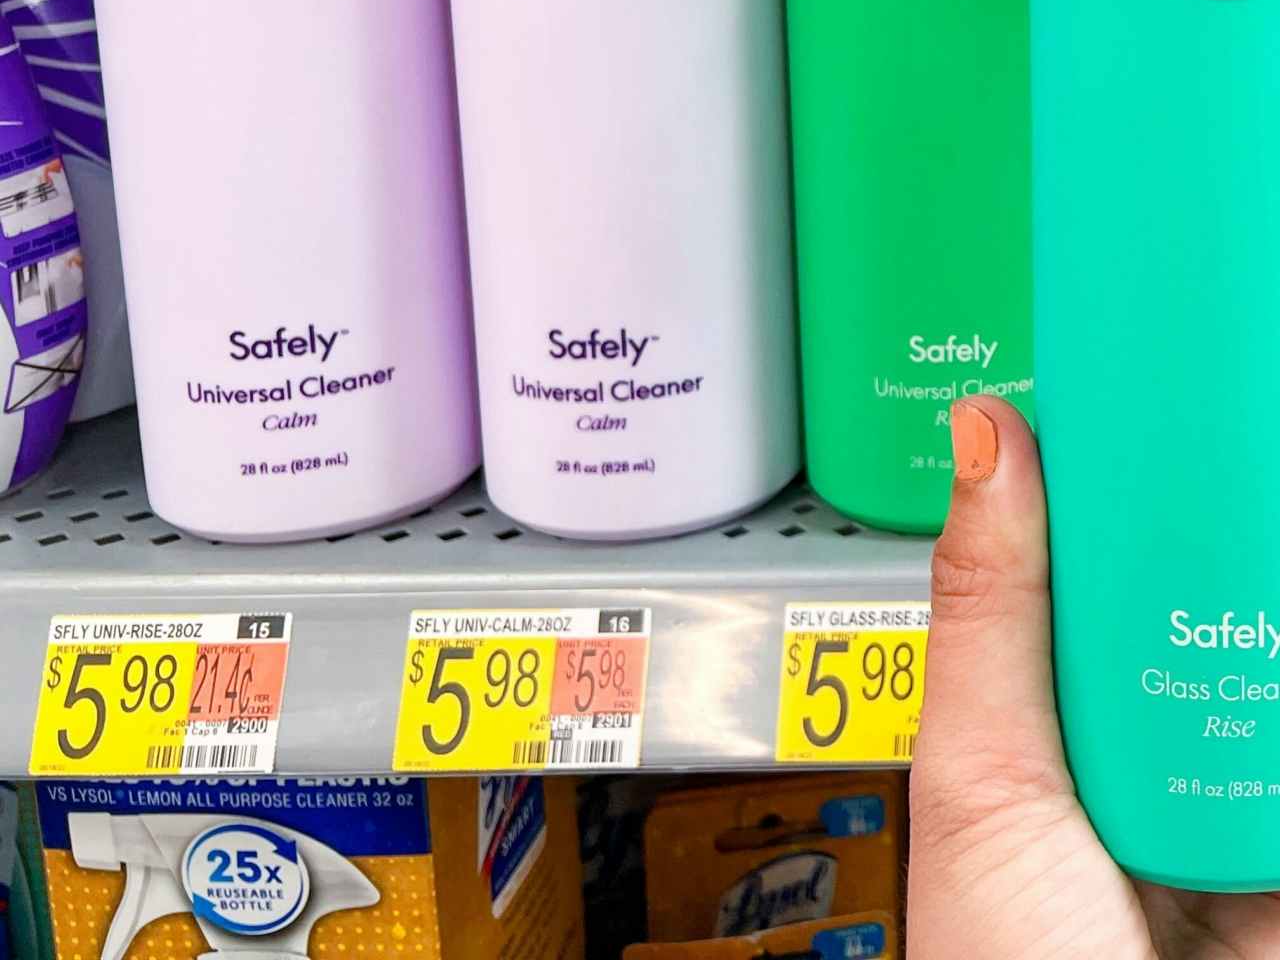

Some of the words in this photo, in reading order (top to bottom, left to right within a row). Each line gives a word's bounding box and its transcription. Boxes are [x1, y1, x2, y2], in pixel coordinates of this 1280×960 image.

[229, 323, 339, 363] Safely
[548, 328, 649, 368] Safely
[908, 333, 999, 369] Safely
[186, 378, 292, 405] Universal
[299, 366, 396, 399] Cleaner
[511, 373, 604, 403] Universal
[610, 375, 704, 403] Cleaner
[873, 375, 957, 401] Universal
[261, 411, 318, 432] Calm
[576, 414, 627, 432] Calm
[240, 463, 257, 476] 28
[271, 463, 288, 474] oz
[290, 456, 322, 476] (828
[556, 460, 571, 473] 28
[414, 617, 450, 633] SFLY
[454, 616, 573, 633] UNIV-CALM-28OZ
[608, 616, 630, 632] 16
[790, 610, 825, 626] SFLY
[53, 624, 89, 640] SFLY
[92, 622, 203, 640] UNIV-RISE-28OZ
[248, 622, 271, 638] 15
[93, 645, 123, 654] PRICE
[1141, 667, 1211, 701] Glass
[231, 717, 268, 733] 2900
[1201, 714, 1257, 739] Rise
[47, 786, 67, 802] VS
[128, 789, 183, 807] LEMON
[186, 790, 216, 807] ALL
[219, 791, 292, 809] PURPOSE
[296, 791, 368, 809] CLEANER
[372, 791, 392, 808] 32
[1167, 776, 1188, 794] 28
[1191, 778, 1201, 796] fl
[1204, 783, 1225, 798] oz
[1227, 780, 1264, 801] (828
[206, 887, 284, 901] REUSEABLE
[219, 899, 273, 913] BOTTLE
